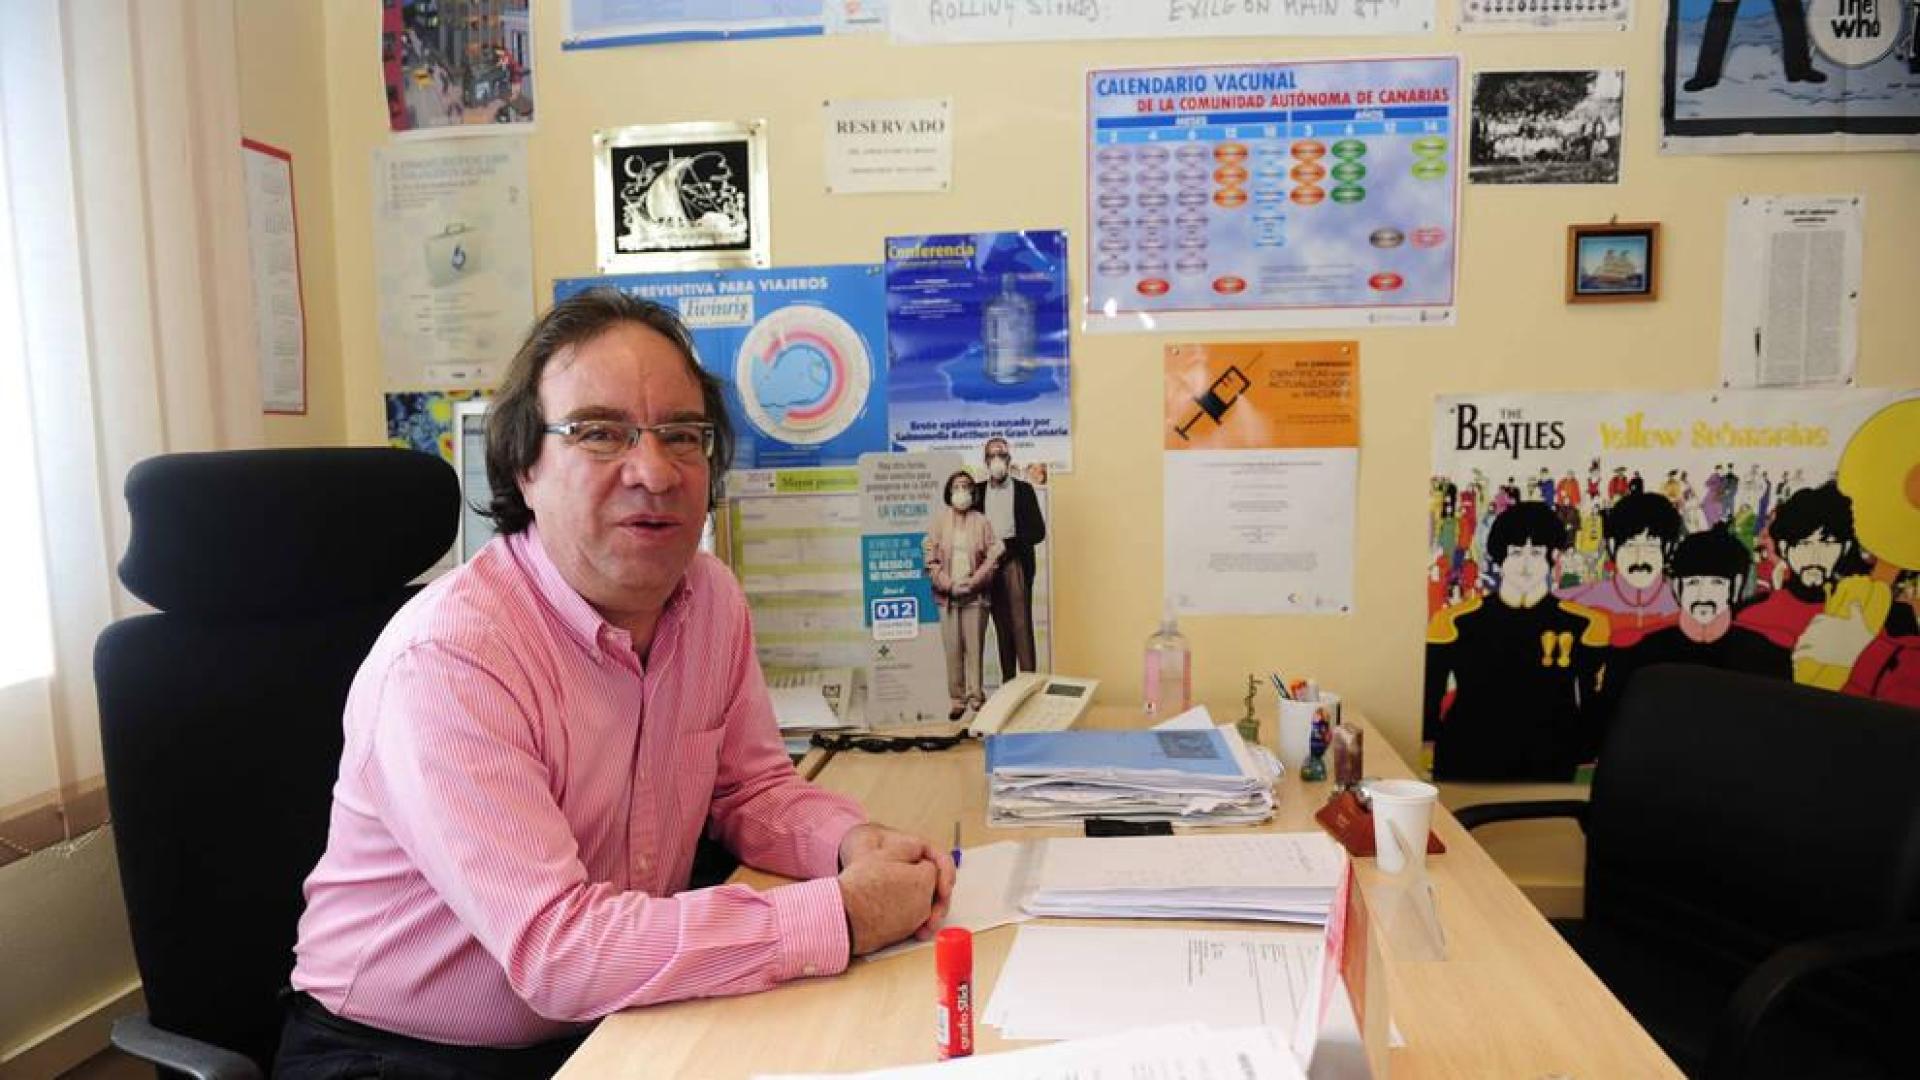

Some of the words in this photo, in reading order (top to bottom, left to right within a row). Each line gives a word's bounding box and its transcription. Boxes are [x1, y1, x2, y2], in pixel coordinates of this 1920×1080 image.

[1096, 75, 1207, 96] CALENDARIO
[1213, 71, 1297, 91] VACUNAL
[1136, 98, 1153, 112] DE
[1159, 98, 1174, 111] LA
[1180, 94, 1265, 111] COMUNIDAD
[1271, 89, 1350, 108] AUTÓNOMA
[1357, 91, 1372, 105] DE
[1378, 88, 1450, 104] CANARIAS
[836, 118, 947, 135] RESERVADO
[887, 239, 976, 259] Conferencia
[632, 282, 715, 298] PREVENTIVA
[719, 280, 755, 294] PARA
[759, 276, 829, 292] VIAJEROS
[1500, 408, 1521, 419] THE
[1455, 403, 1566, 460] BEATLES
[1597, 411, 1682, 449] Yellow
[1691, 418, 1831, 449] Submarine
[877, 603, 914, 618] 012
